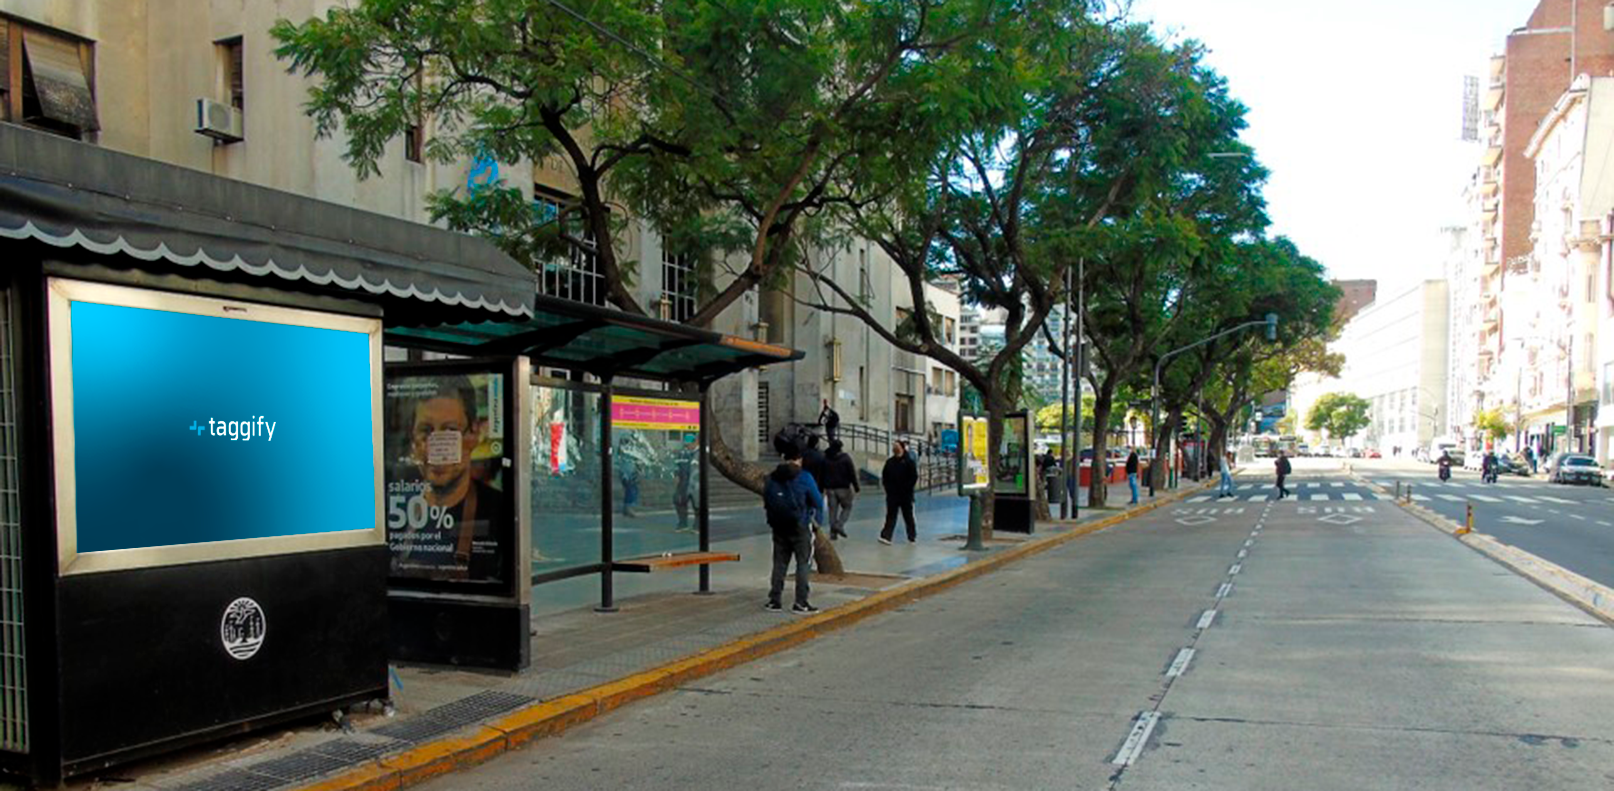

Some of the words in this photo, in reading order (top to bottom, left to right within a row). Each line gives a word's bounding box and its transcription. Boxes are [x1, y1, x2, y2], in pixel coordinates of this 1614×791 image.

[208, 415, 277, 441] taggify
[388, 479, 432, 492] salarios
[388, 495, 454, 529] 50%
[389, 531, 420, 541] pagados
[420, 532, 433, 541] por
[434, 531, 441, 540] el
[389, 542, 422, 552] Gobierno
[423, 542, 453, 552] nacional
